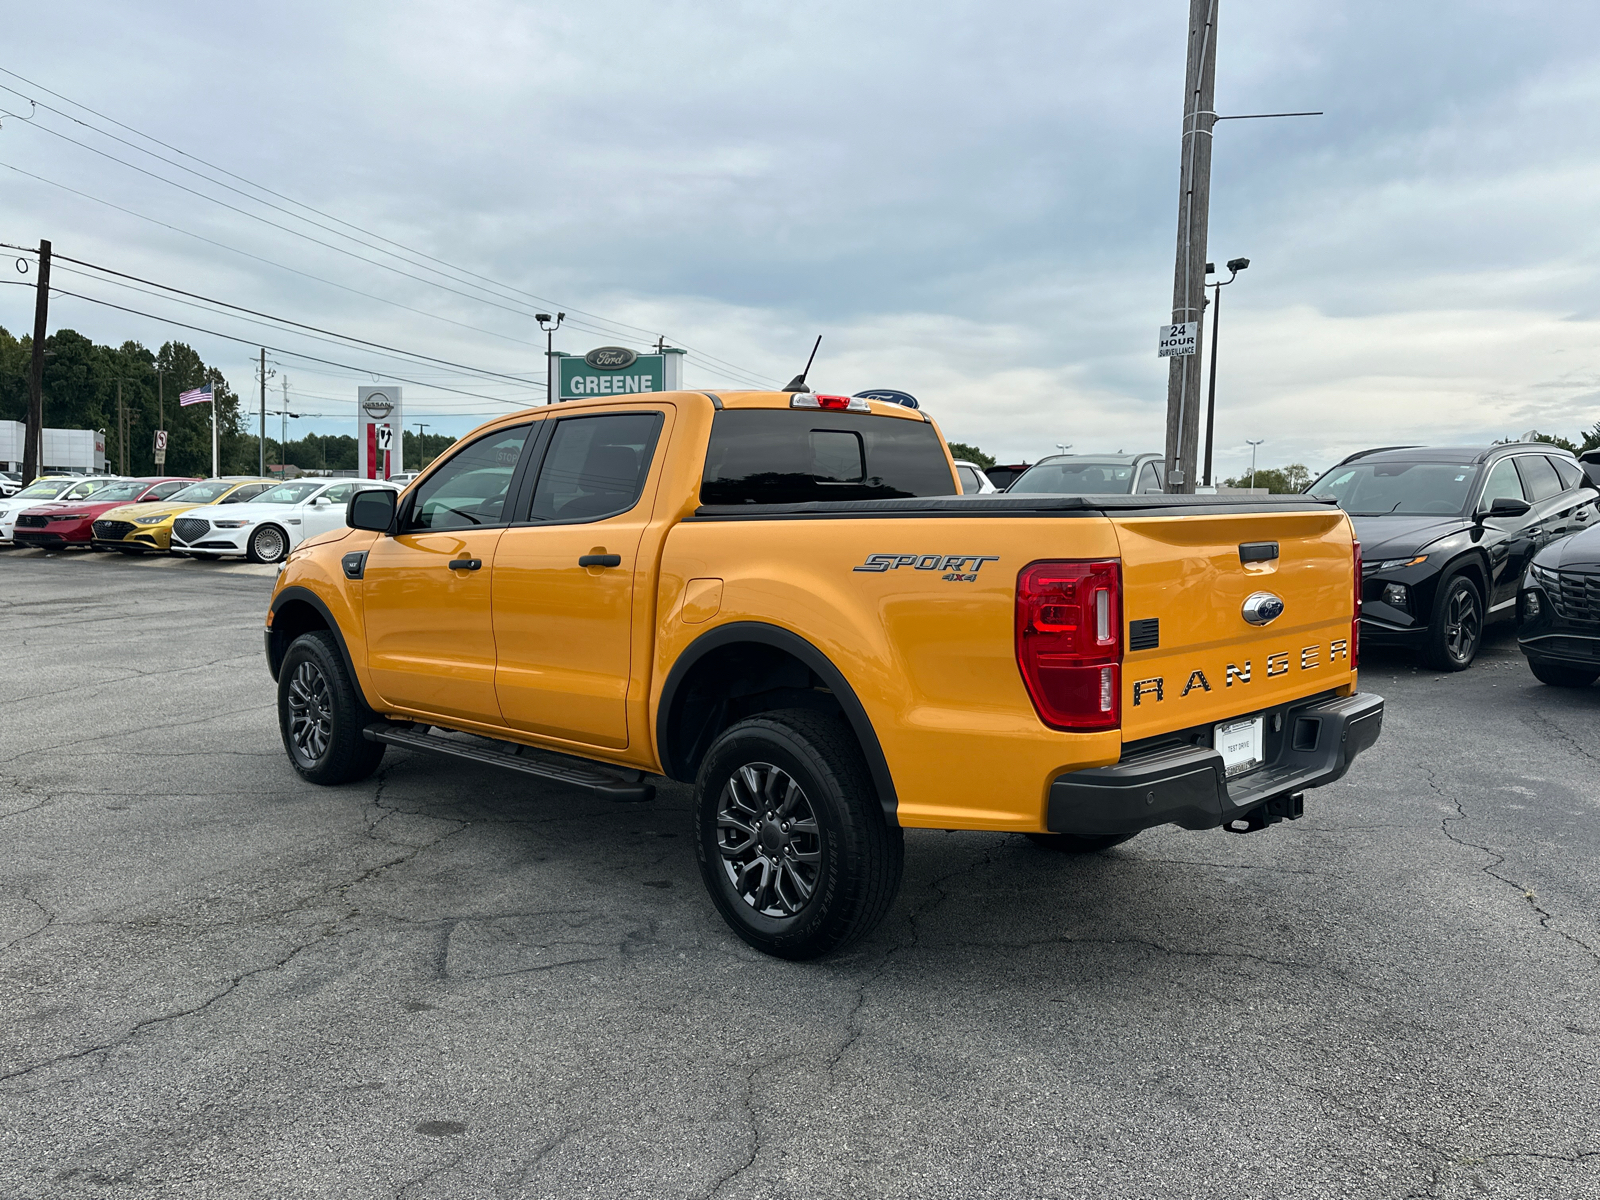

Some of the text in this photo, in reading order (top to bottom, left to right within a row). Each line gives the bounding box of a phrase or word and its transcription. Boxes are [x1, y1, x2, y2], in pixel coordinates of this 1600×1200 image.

[1170, 324, 1186, 337] 24
[1161, 337, 1195, 347] HOUR
[597, 351, 624, 365] Ford
[1159, 346, 1194, 357] SURVEILLANCE
[570, 375, 653, 394] GREENE
[497, 451, 518, 463] STOP
[853, 553, 1000, 573] SPORT
[1132, 639, 1347, 707] RANGER
[1228, 741, 1250, 753] TEST DRIVE
